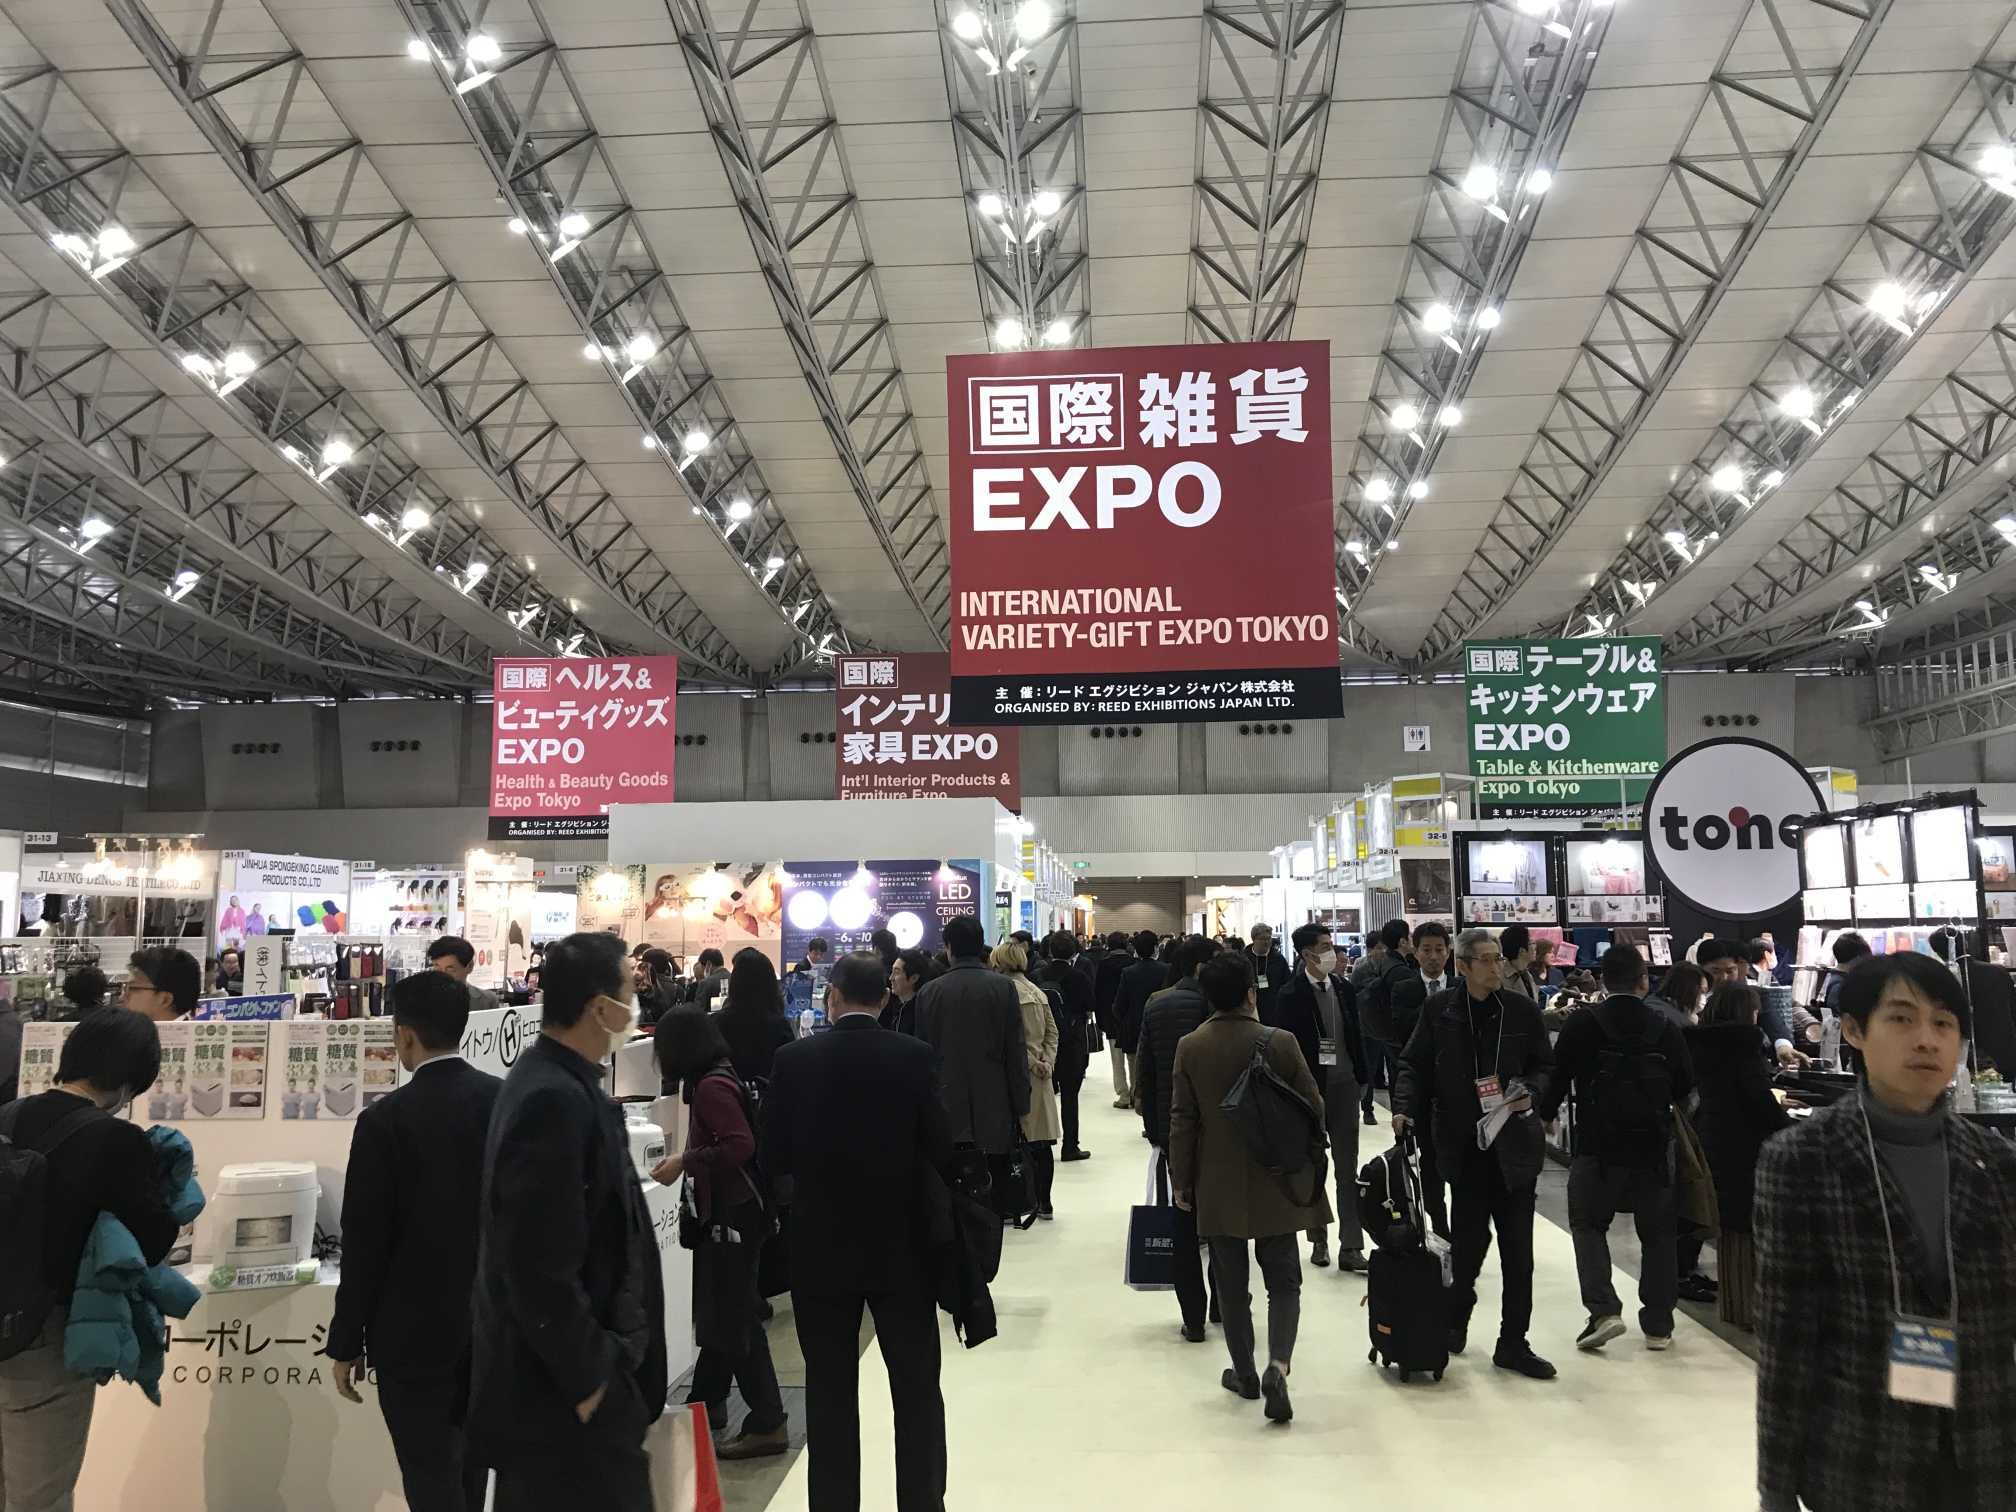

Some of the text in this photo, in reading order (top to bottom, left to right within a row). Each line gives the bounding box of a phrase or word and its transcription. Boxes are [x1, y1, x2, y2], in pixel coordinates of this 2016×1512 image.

[978, 366, 1310, 448] 国際 雑貨
[972, 460, 1223, 532] EXPO
[960, 586, 1182, 617] INTERNATIONAL
[961, 613, 1330, 651] VARIETY-GIFT EXPO TOKYO
[1469, 643, 1658, 677] 国際 テーブル&
[502, 663, 653, 692] 国際 ヘルス&
[843, 660, 895, 686] 国際
[1045, 683, 1084, 699] リード
[1088, 682, 1181, 697] エグジビション
[1469, 682, 1657, 716] キッチンウェア
[497, 695, 671, 731] ビューティグッズ
[994, 696, 1296, 714] ORGANISED BY: REED EXHIBITIONS JAPAN LTD.
[911, 732, 999, 761] EXPO
[1474, 722, 1571, 752] EXPO
[497, 737, 585, 765] EXPO
[1476, 757, 1660, 776] Table & Kitchenware
[495, 771, 669, 791] Health & Beauty Goods
[873, 773, 928, 787] Interior
[931, 773, 996, 786] Products
[999, 772, 1011, 785] &
[1478, 779, 1580, 800] Expo Tokyo
[494, 792, 581, 812] Expo Tokyo
[841, 788, 948, 801] Furniture Expo
[38, 870, 83, 885] JIAXING
[242, 859, 340, 876] JINHUA SPONGEKING CLEANING
[262, 874, 297, 887] PRODUCTS
[939, 883, 972, 900] LED
[935, 906, 975, 916] CEILING
